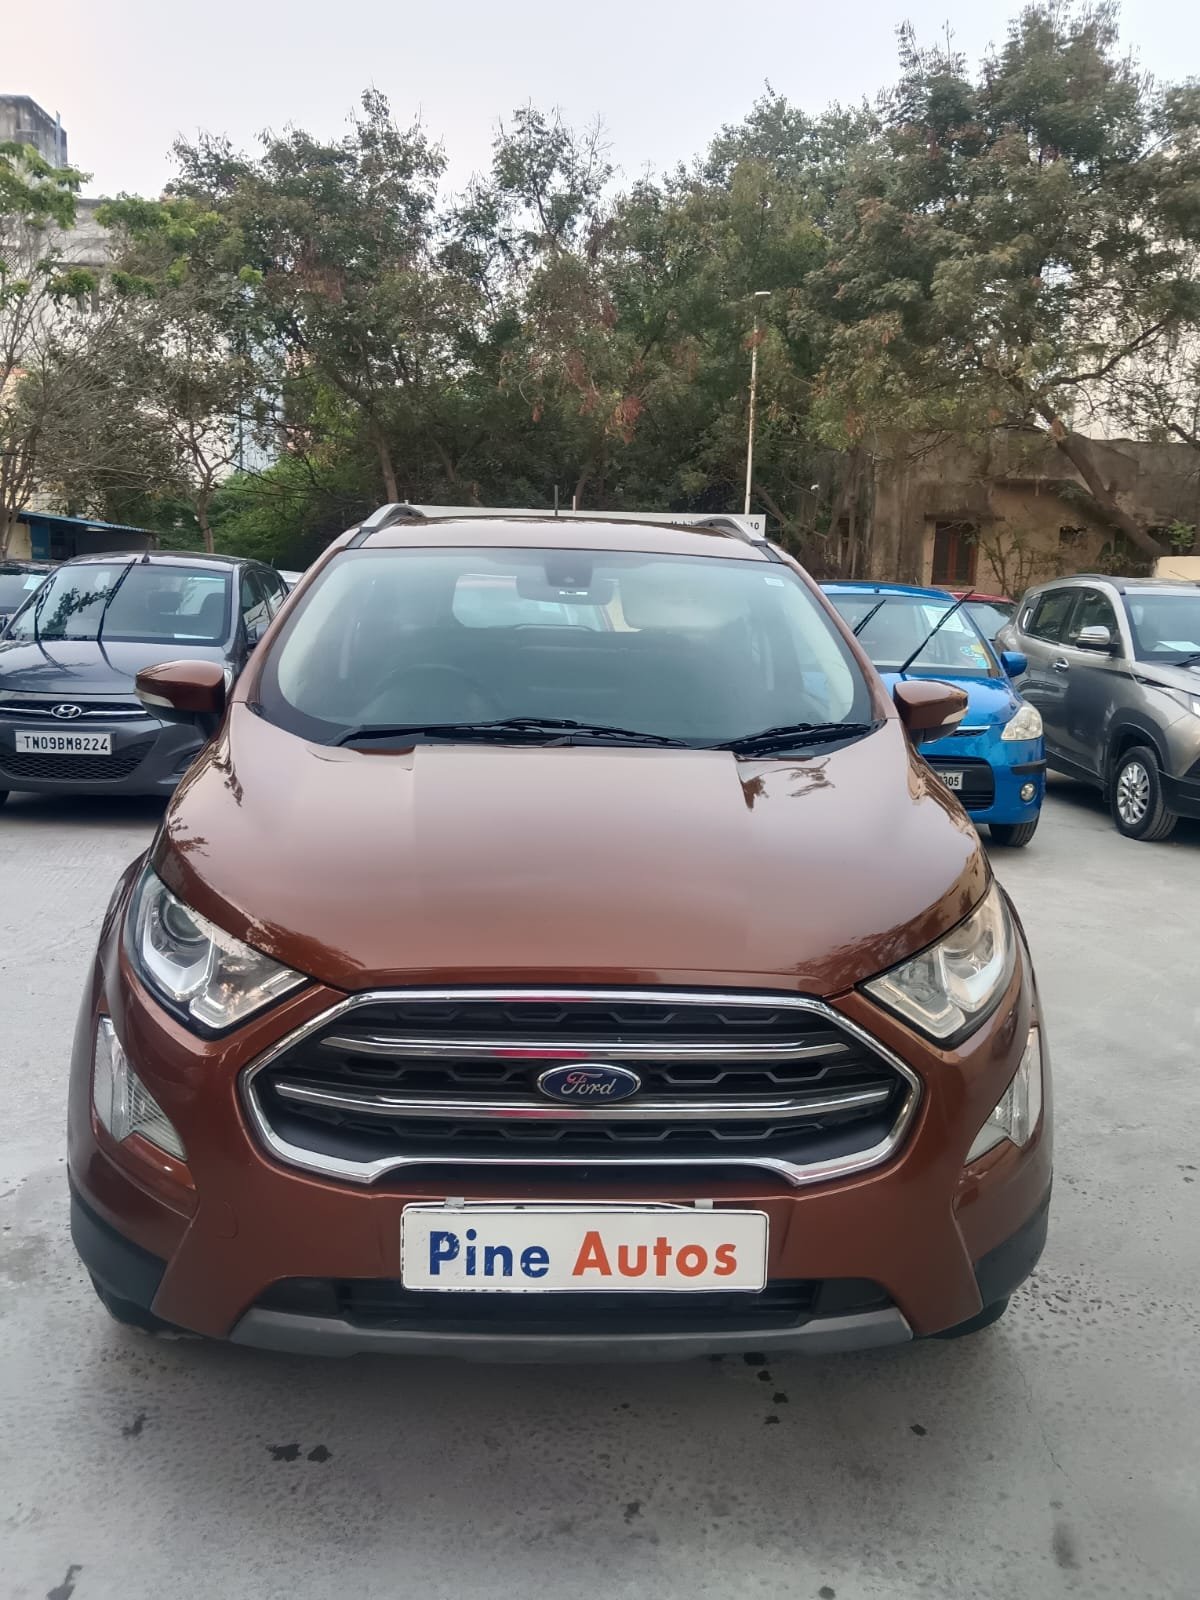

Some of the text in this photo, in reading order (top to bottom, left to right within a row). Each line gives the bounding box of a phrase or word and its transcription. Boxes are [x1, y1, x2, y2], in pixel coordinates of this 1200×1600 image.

[24, 735, 109, 751] TN09BM8224
[560, 1071, 617, 1095] Ford
[429, 1228, 737, 1278] Pine Autos
